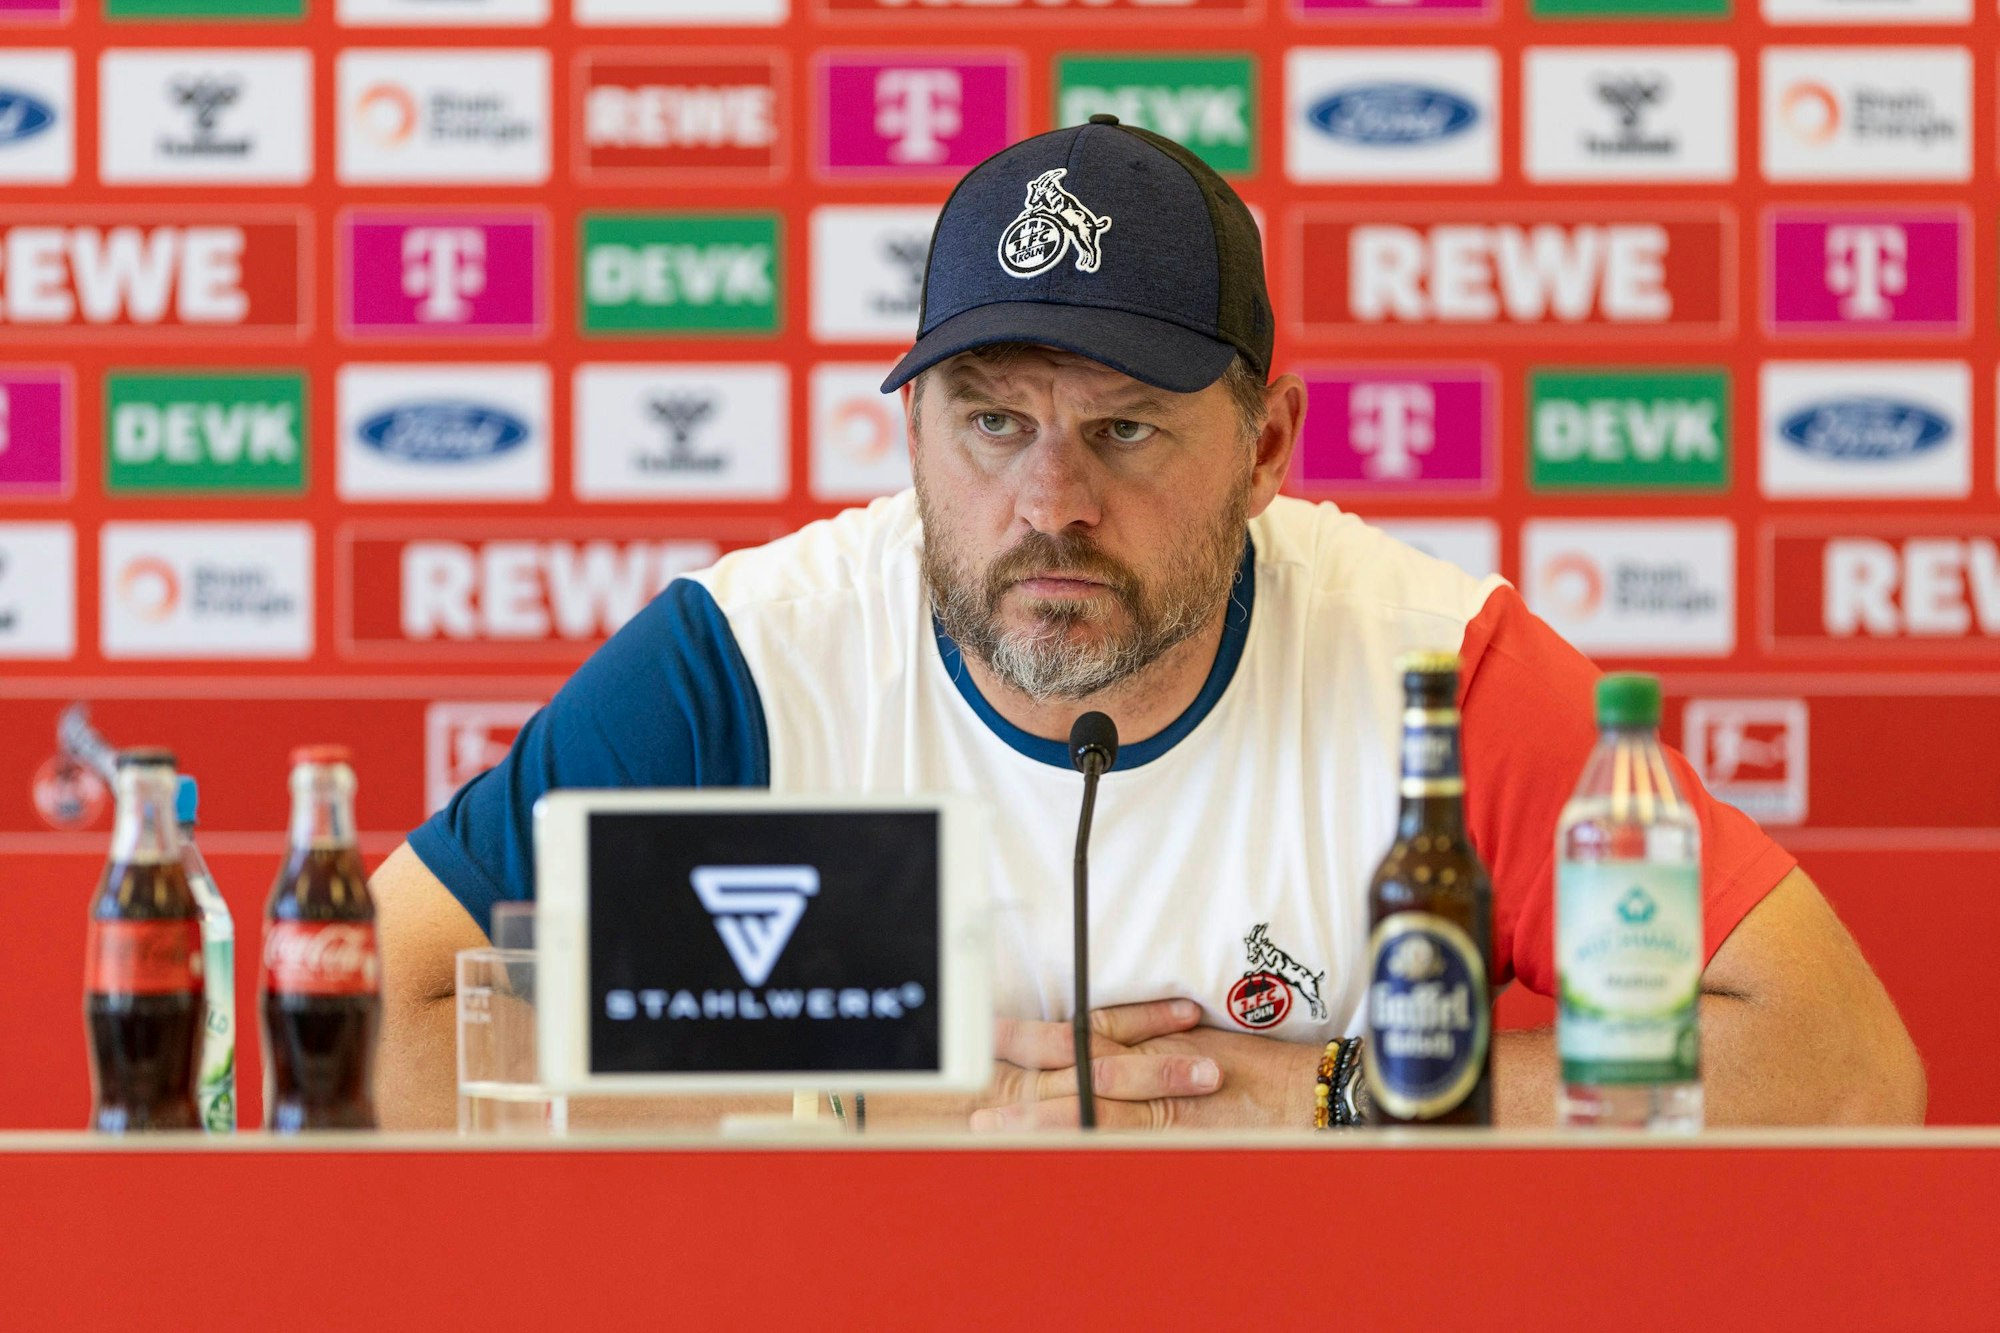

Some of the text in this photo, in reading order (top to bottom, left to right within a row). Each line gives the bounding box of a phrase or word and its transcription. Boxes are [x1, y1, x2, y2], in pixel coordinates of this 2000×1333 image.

[585, 84, 777, 148] REWE
[0, 226, 249, 323] EWE
[588, 244, 772, 305] DEVK
[1348, 224, 1673, 323] REWE
[112, 401, 297, 464] DEVK
[1536, 399, 1721, 461] DEVK
